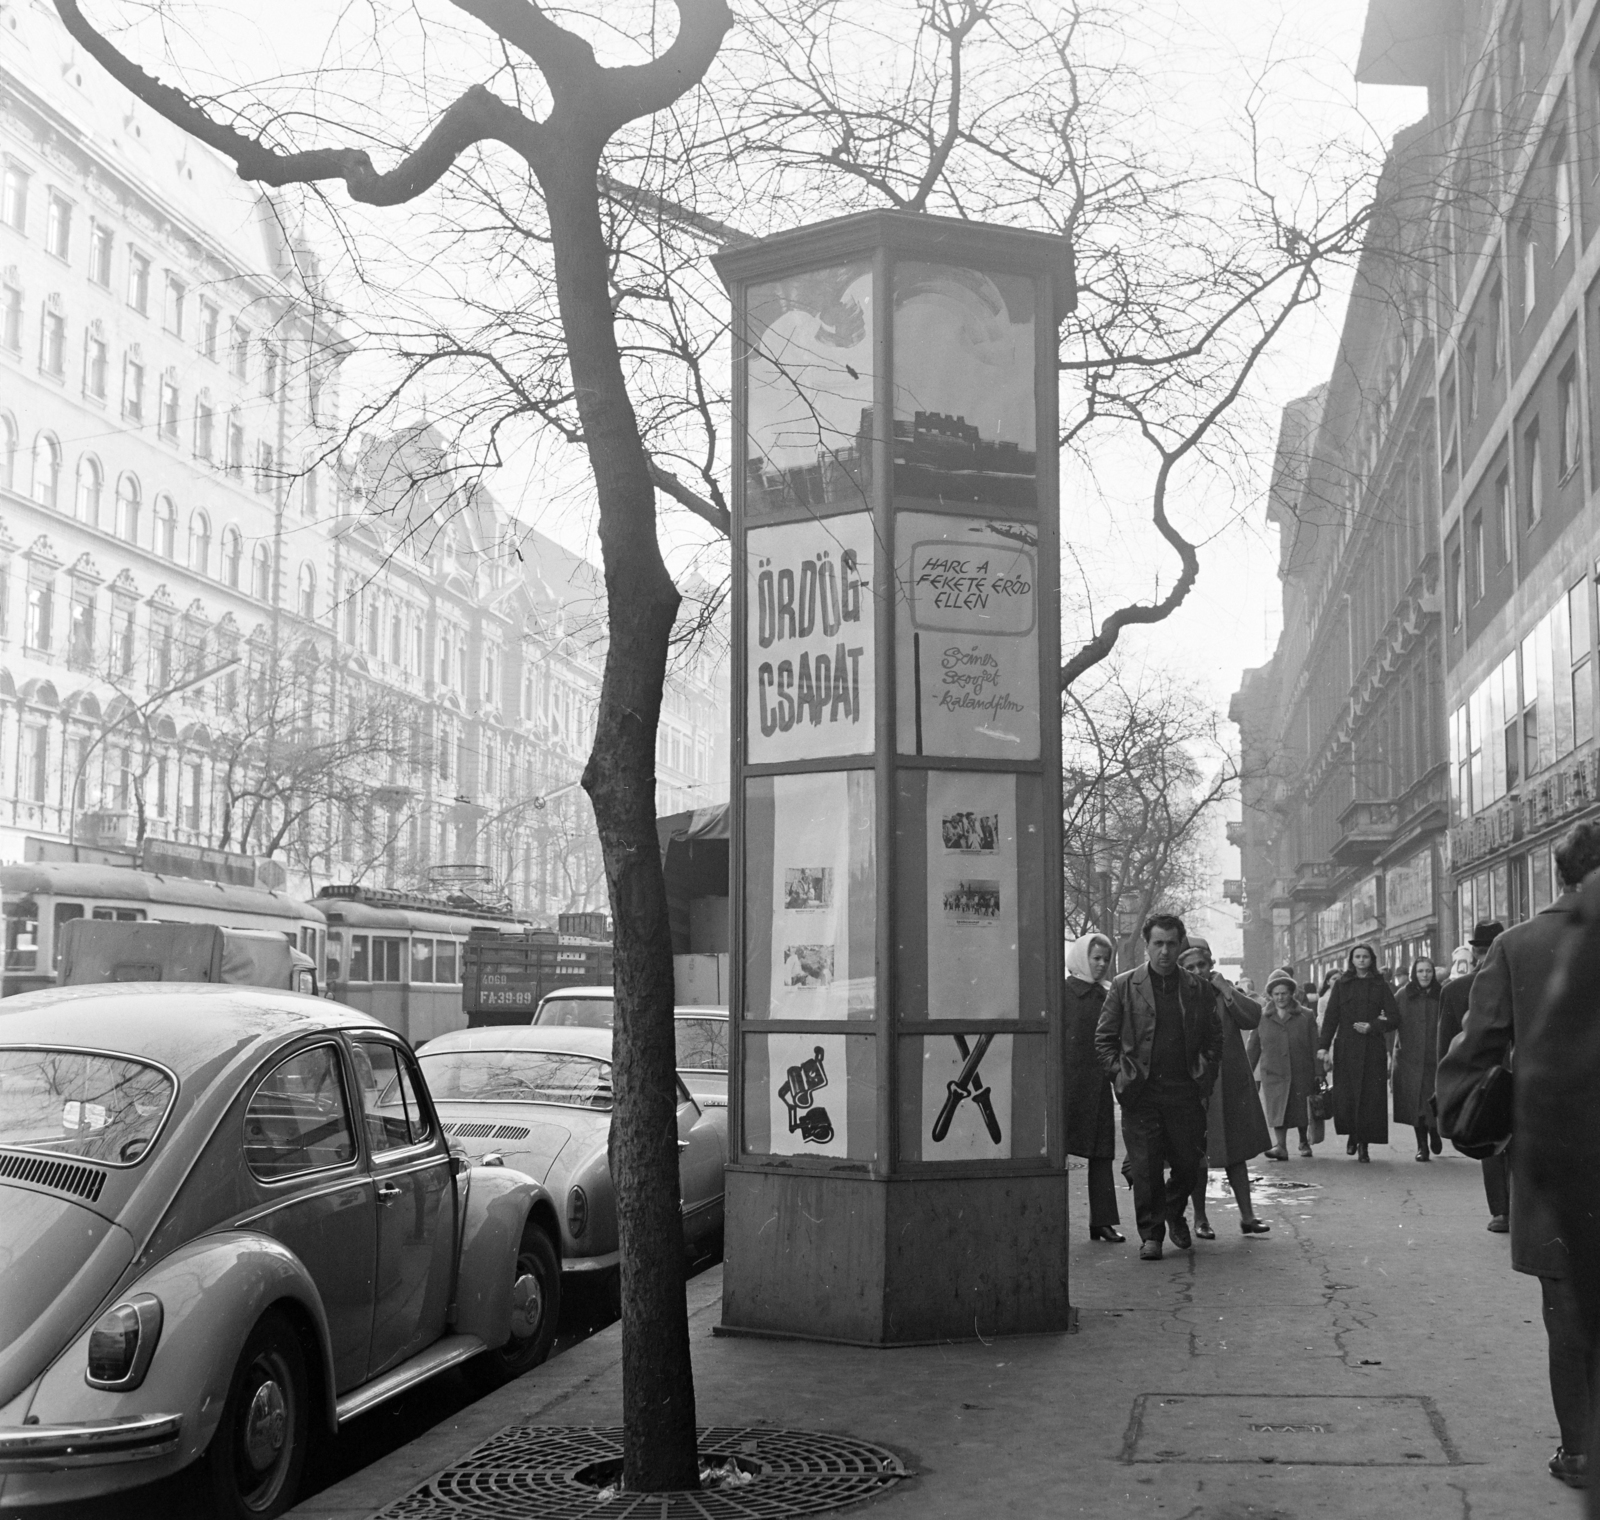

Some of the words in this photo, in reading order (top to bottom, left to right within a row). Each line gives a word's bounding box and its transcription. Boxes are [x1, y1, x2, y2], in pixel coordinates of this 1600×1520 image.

[921, 557, 971, 575] HARC
[976, 560, 989, 575] A
[916, 573, 987, 594] FEKETE
[934, 591, 989, 610] ELLEN
[758, 642, 864, 738] CSAPAT
